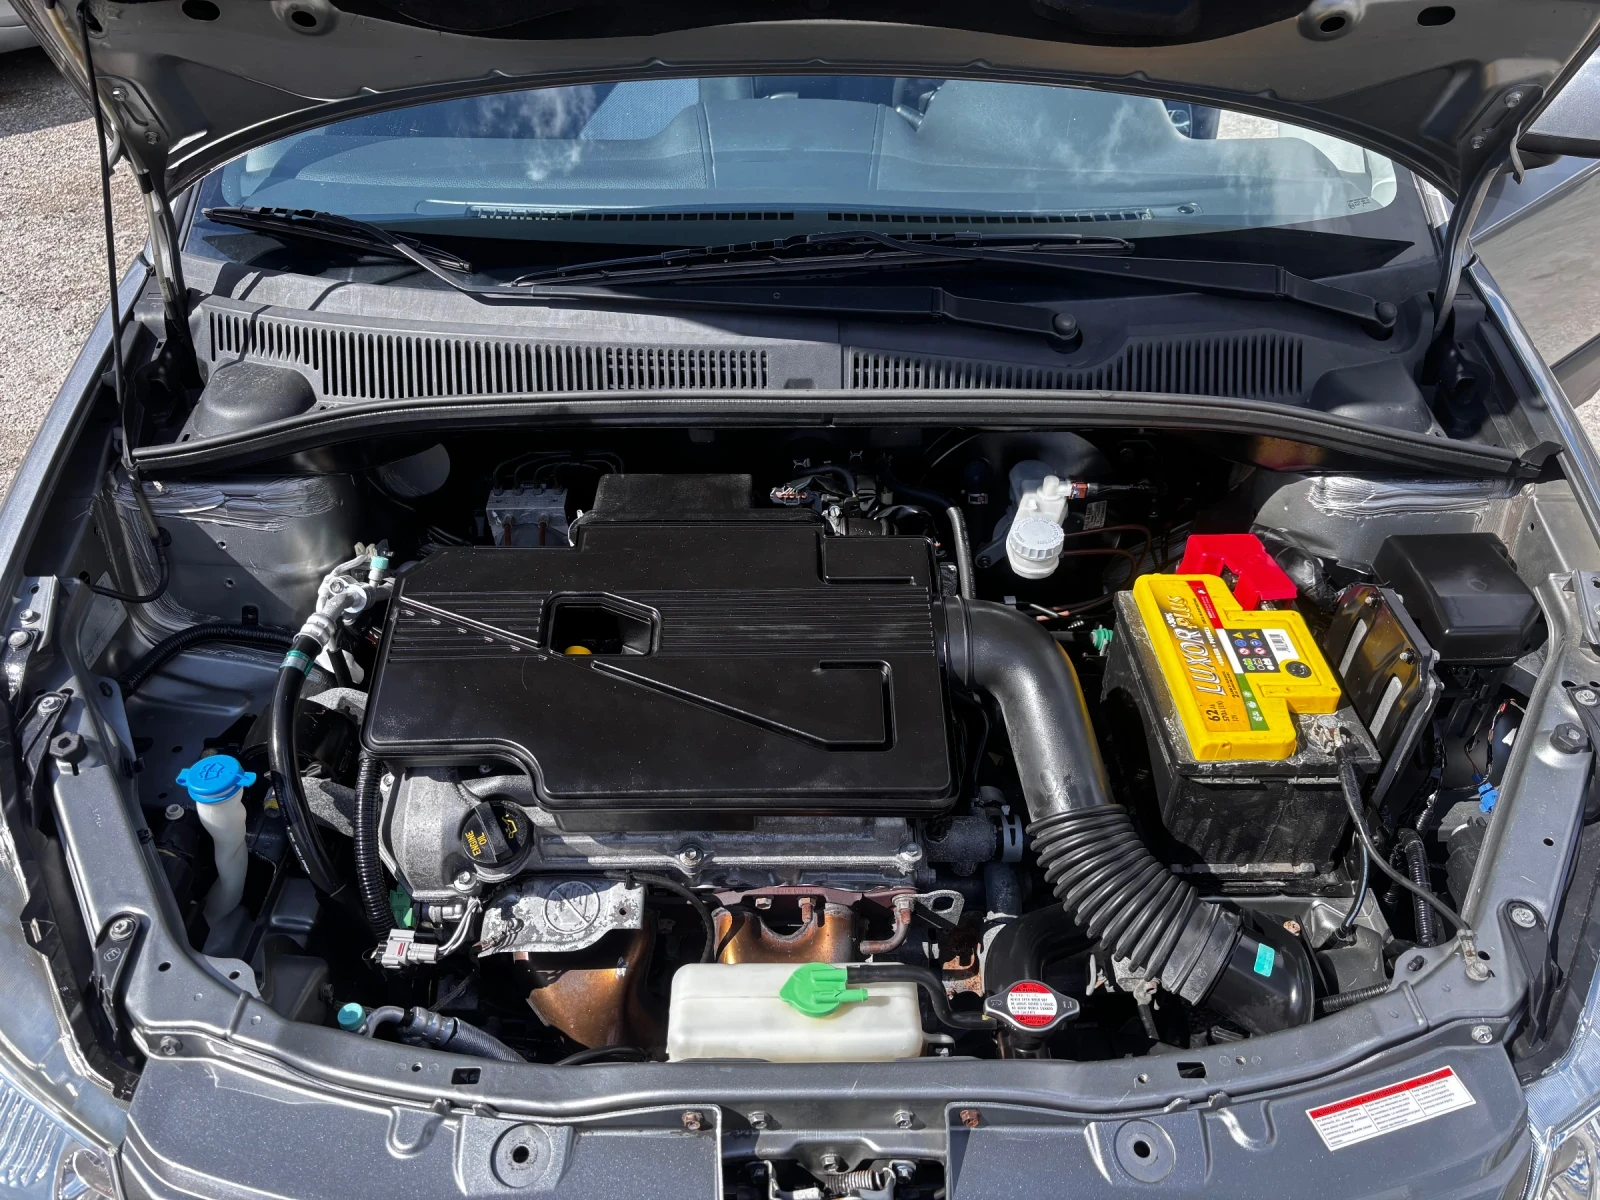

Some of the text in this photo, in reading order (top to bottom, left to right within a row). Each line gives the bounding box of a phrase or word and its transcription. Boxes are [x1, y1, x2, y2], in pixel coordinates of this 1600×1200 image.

[1174, 628, 1226, 696] LUXOR
[465, 830, 481, 856] ENGINE
[477, 832, 487, 846] OIL
